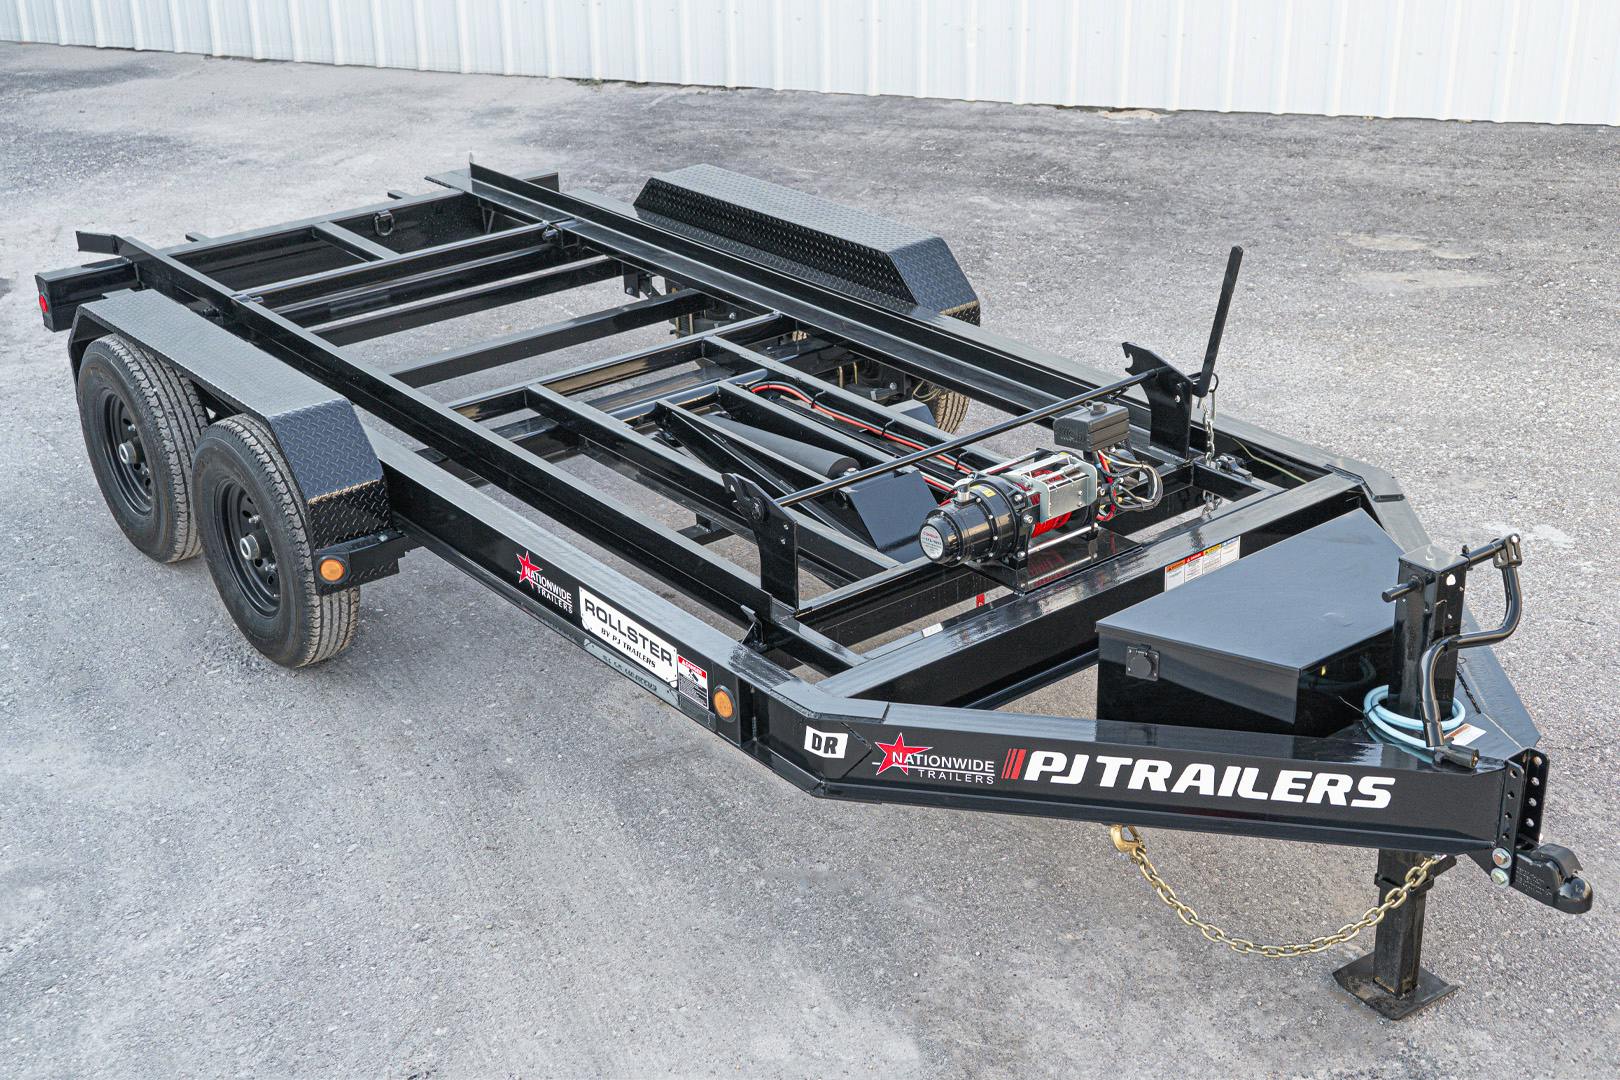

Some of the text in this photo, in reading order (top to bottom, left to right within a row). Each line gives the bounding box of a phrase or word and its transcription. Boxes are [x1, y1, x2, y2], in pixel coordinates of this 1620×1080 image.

[524, 564, 572, 603] NATIONWIDE
[537, 586, 573, 614] TRAILERS
[585, 598, 673, 667] ROLLSTER
[601, 627, 656, 668] BY PJ TRAILERS
[811, 732, 839, 756] DR
[892, 750, 995, 773] NATIONWIDE
[918, 768, 995, 785] TRAILERS
[1024, 750, 1395, 809] PJ TRAILERS
